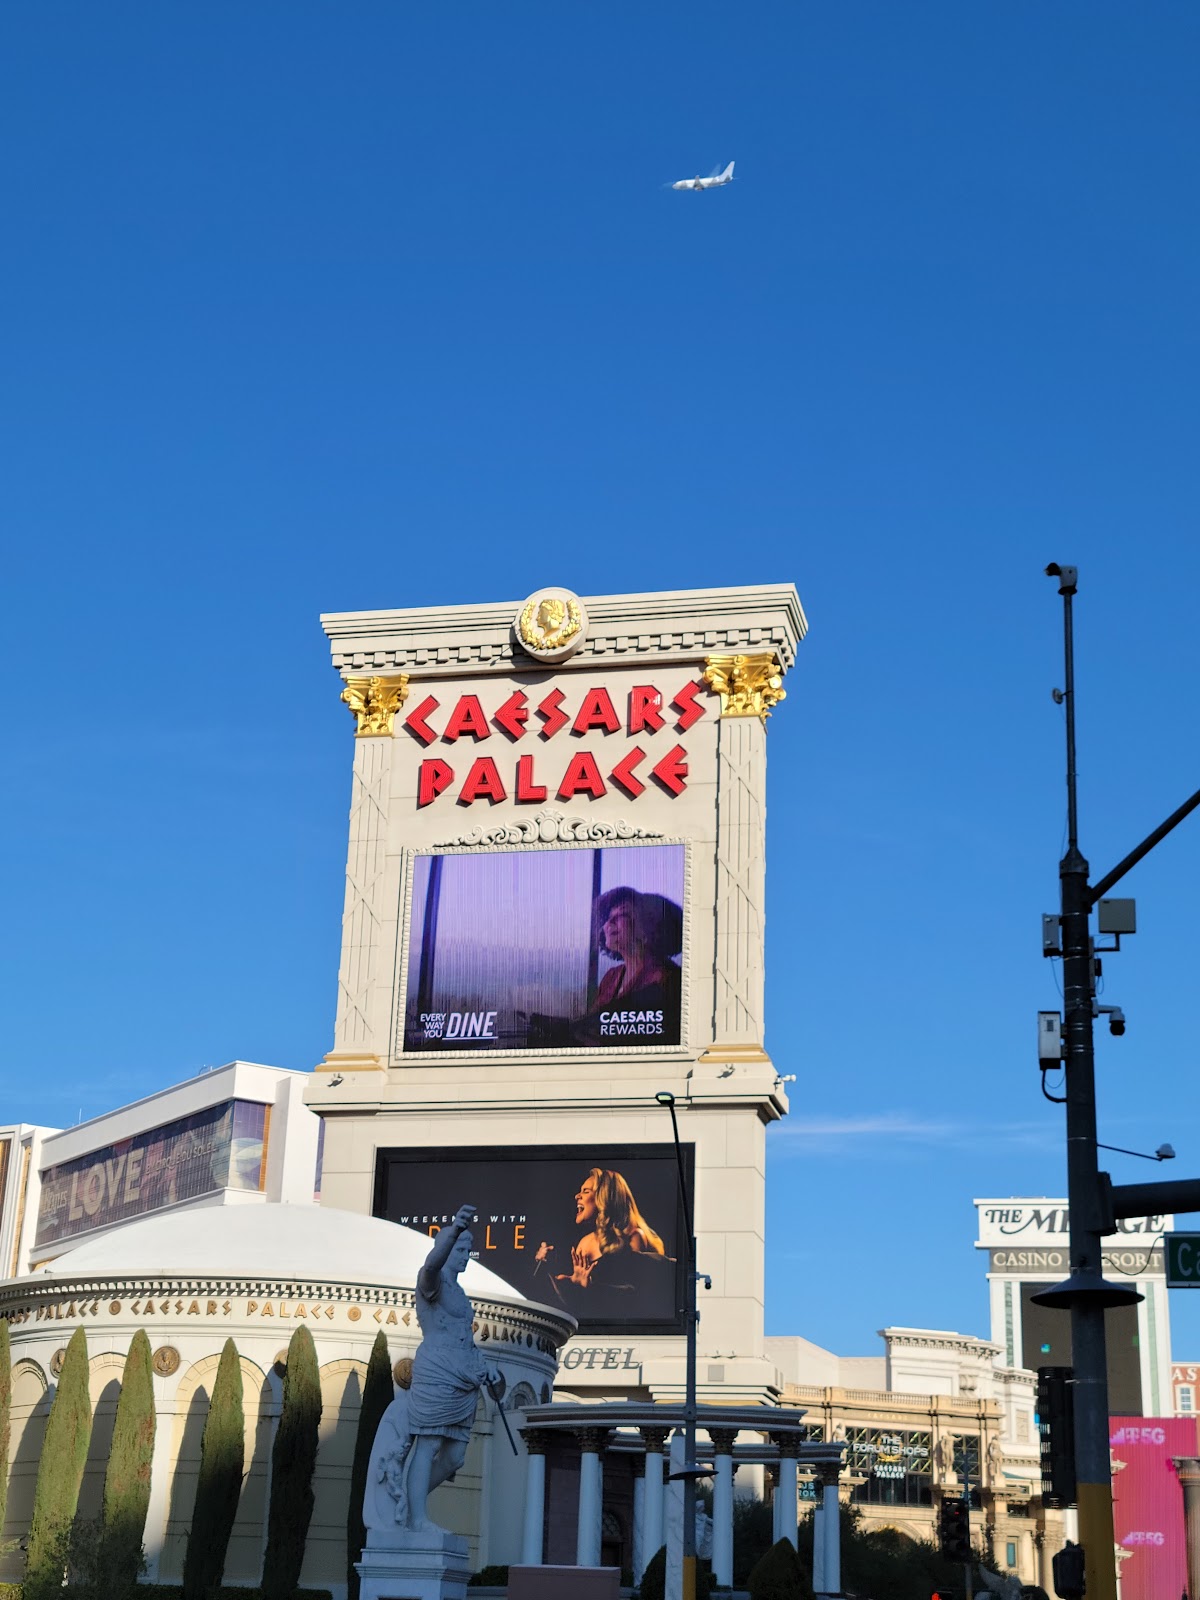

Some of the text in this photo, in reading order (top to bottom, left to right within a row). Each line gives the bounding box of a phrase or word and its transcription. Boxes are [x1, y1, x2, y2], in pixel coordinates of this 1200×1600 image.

[404, 680, 706, 748] CAESARS
[417, 744, 688, 806] PALACE
[420, 1013, 447, 1022] EVERY
[600, 1010, 664, 1023] CAESARS
[425, 1021, 445, 1030] WAY
[446, 1011, 497, 1038] DINE
[600, 1023, 663, 1036] REWARDS
[423, 1029, 443, 1038] YOU
[68, 1147, 145, 1221] LOVE
[400, 1215, 526, 1223] WEEKENS WITH
[985, 1209, 1165, 1234] THE MIGE
[993, 1252, 1162, 1267] CASINO ESORT
[36, 1301, 99, 1322] PALACE
[131, 1300, 232, 1315] CAESARS
[247, 1301, 335, 1320] PALACE
[472, 1321, 522, 1346] PALACE
[880, 1434, 902, 1446] THE
[853, 1443, 929, 1458] FORUM SHOPS
[874, 1464, 907, 1473] CAESARS
[876, 1471, 904, 1479] PALACE
